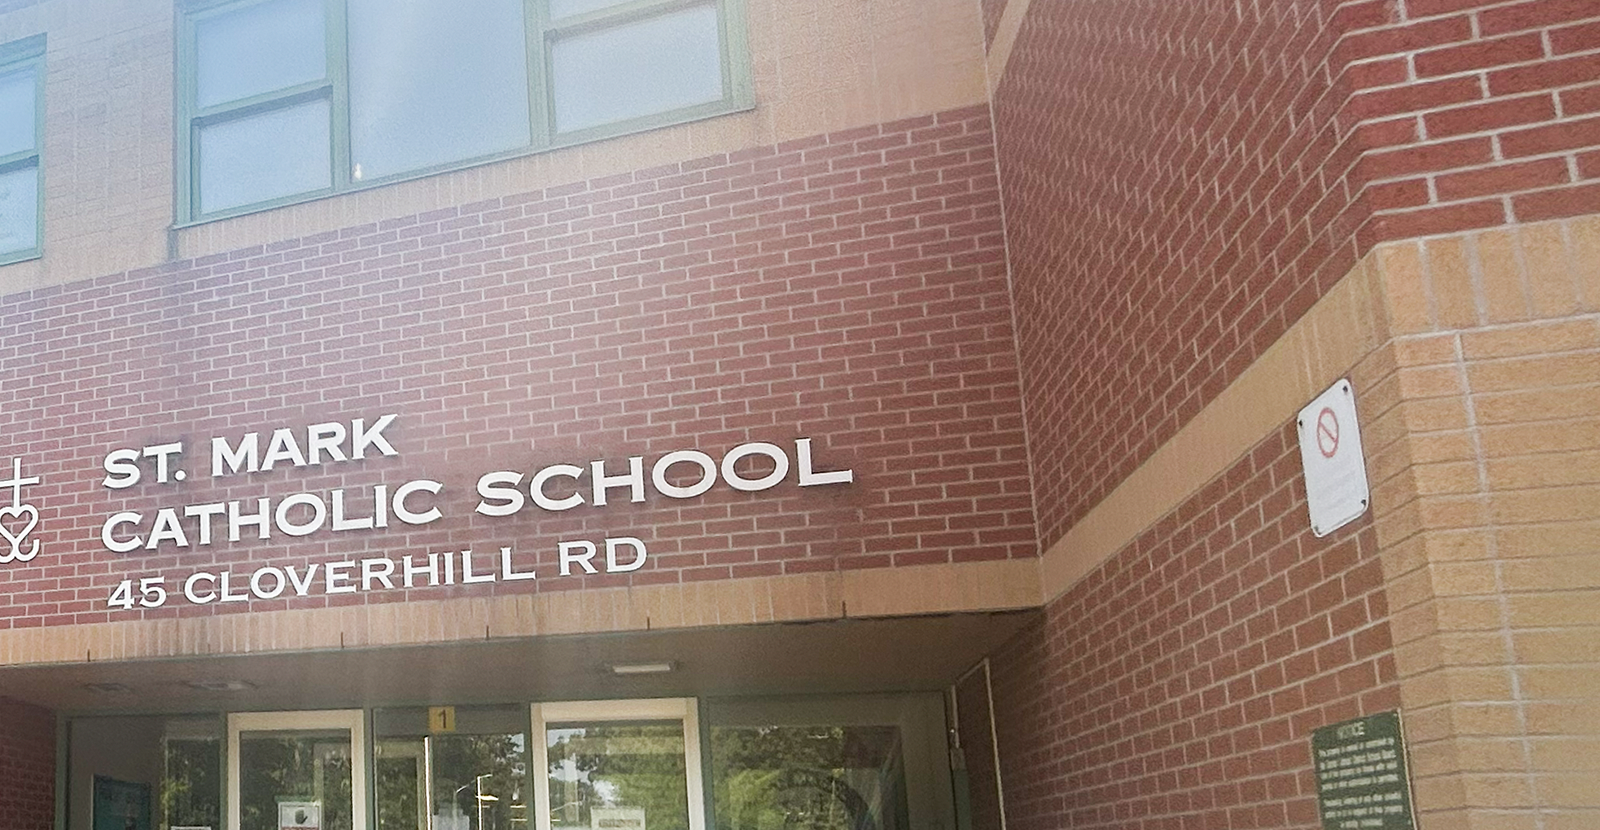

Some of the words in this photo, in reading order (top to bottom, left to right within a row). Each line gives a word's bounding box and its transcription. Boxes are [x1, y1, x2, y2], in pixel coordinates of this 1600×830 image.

[102, 442, 187, 488] ST.
[211, 414, 399, 477] MARK
[101, 480, 443, 552] CATHOLIC
[475, 438, 853, 516] SCHOOL
[108, 576, 166, 609] 45
[184, 547, 536, 604] CLOVERHILL
[558, 537, 647, 576] RD
[437, 709, 447, 729] 1
